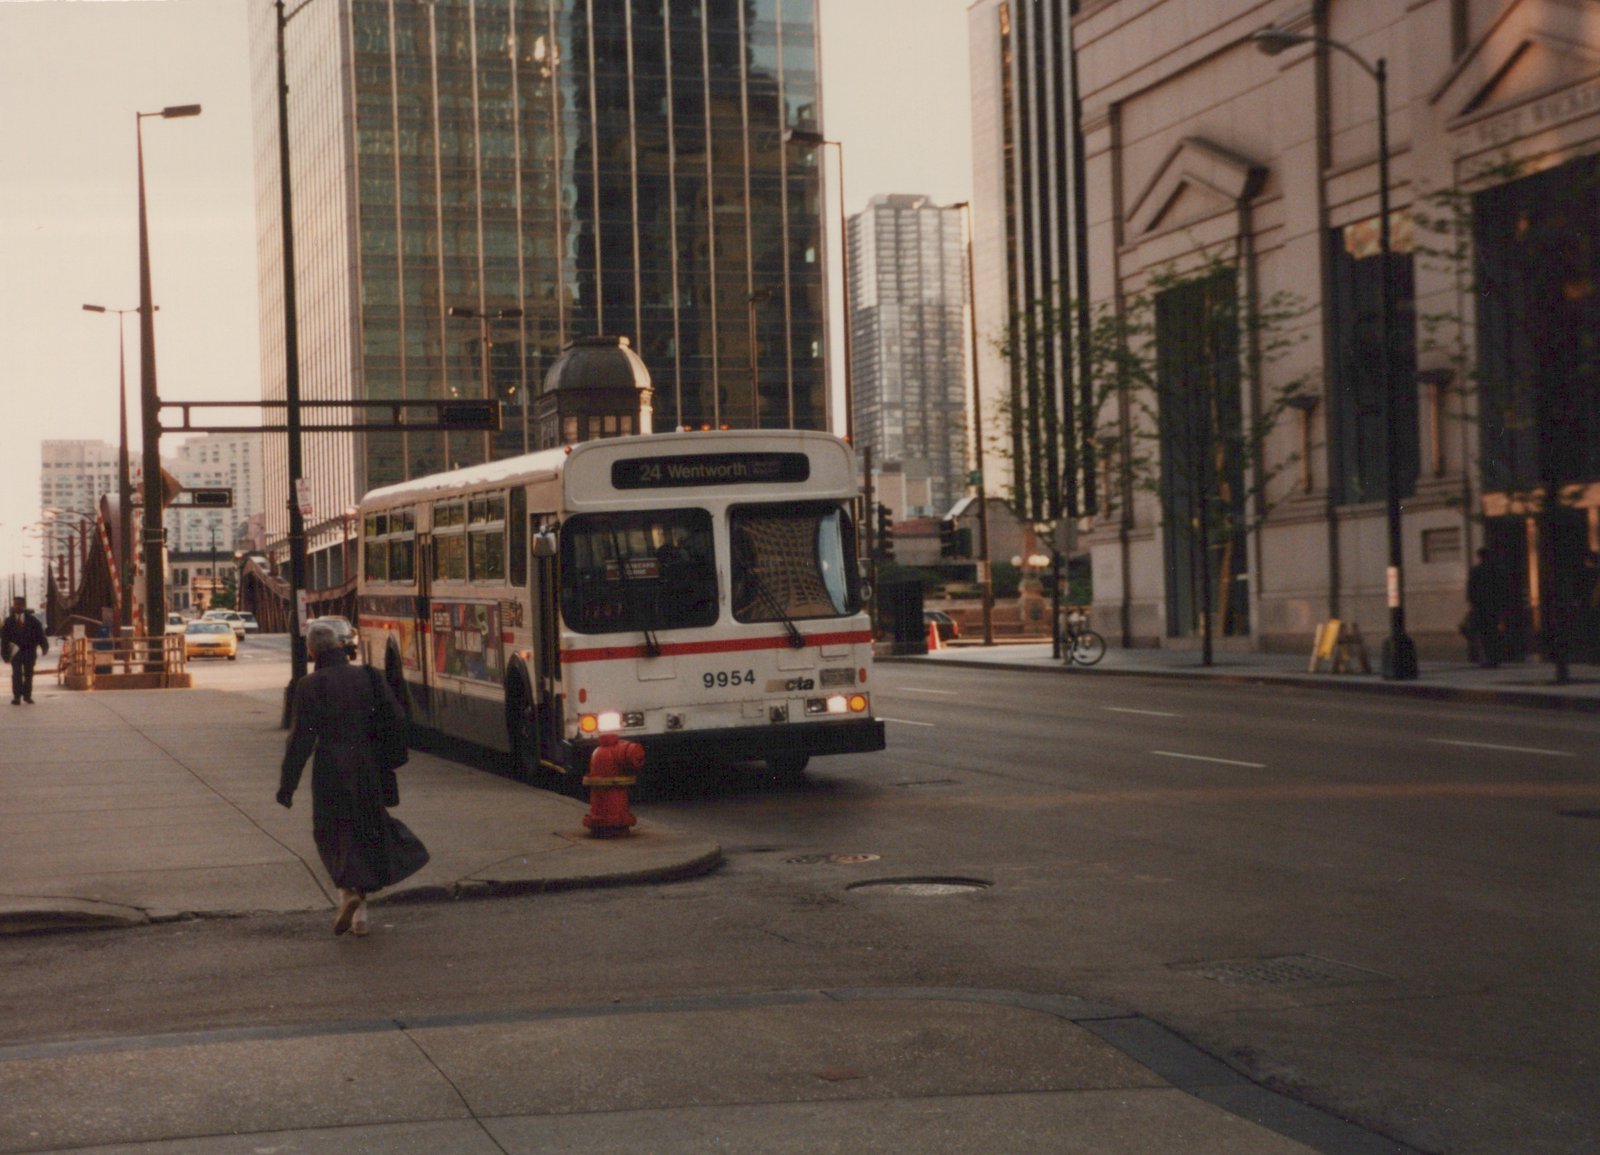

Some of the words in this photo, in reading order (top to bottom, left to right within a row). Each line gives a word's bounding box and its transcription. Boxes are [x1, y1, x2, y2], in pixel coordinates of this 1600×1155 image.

[640, 463, 663, 482] 24
[667, 461, 747, 480] Wentworth
[703, 669, 755, 689] 9954
[785, 676, 815, 692] cta
